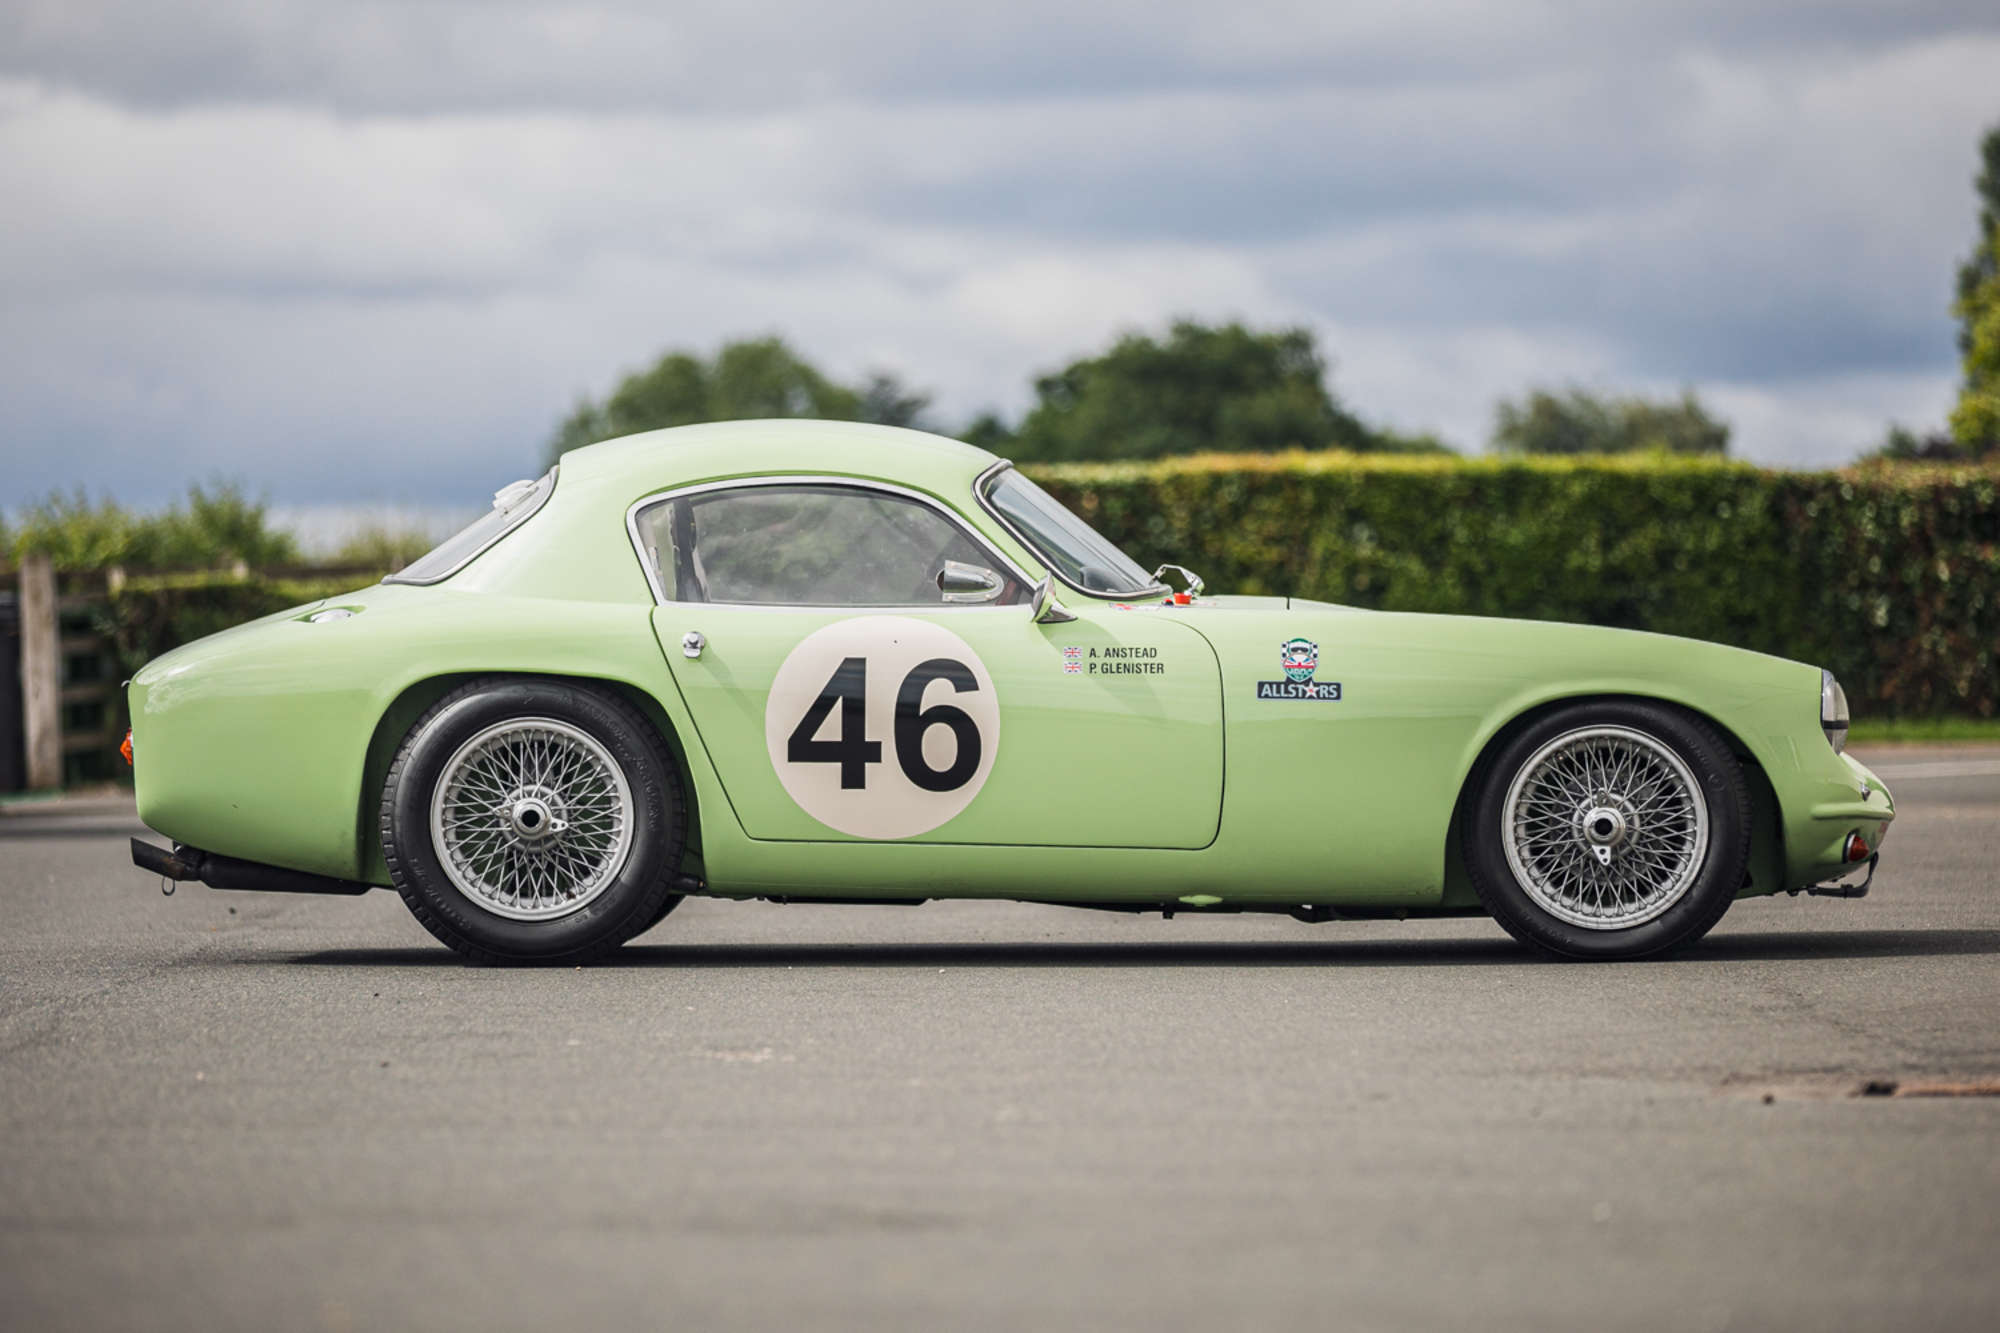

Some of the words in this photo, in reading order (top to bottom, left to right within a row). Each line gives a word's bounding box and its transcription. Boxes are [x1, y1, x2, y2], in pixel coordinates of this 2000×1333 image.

[1089, 647, 1100, 658] A.
[1104, 647, 1158, 658] ANSTEAD
[1089, 663, 1097, 674] P.
[1101, 663, 1165, 674] GLENISTER
[787, 657, 982, 792] 46
